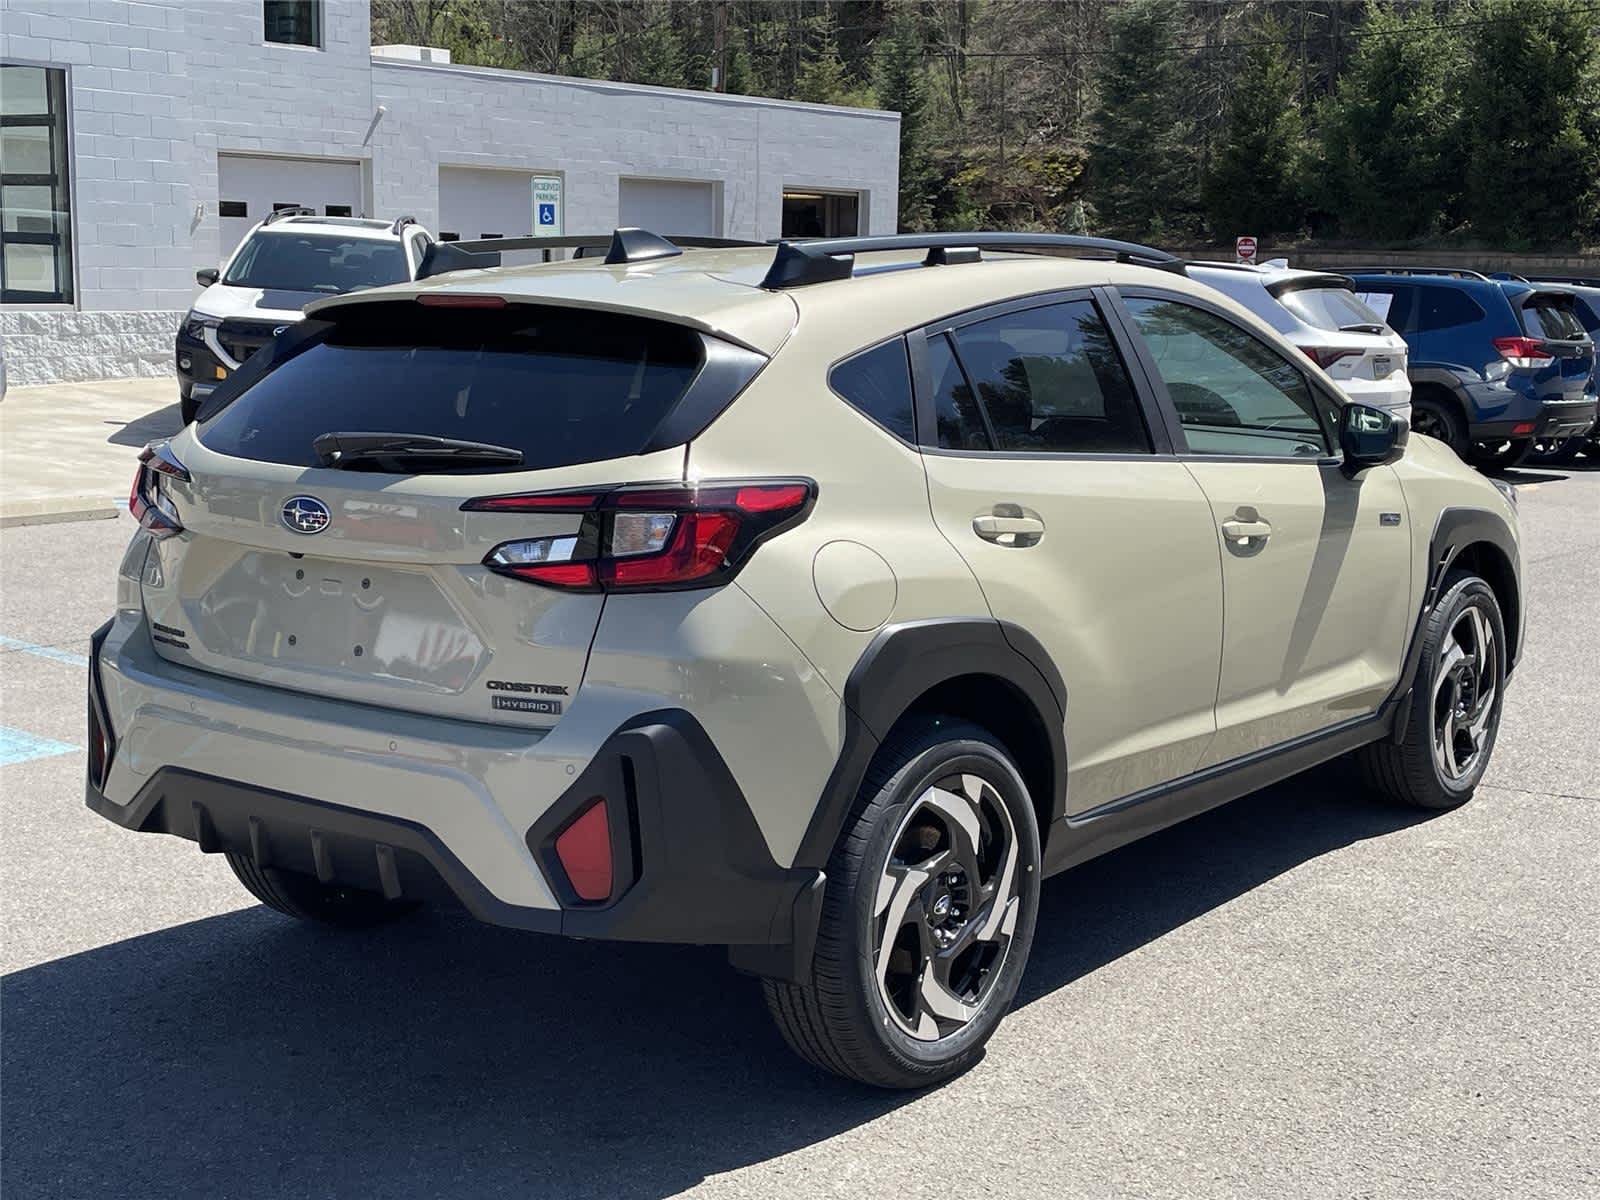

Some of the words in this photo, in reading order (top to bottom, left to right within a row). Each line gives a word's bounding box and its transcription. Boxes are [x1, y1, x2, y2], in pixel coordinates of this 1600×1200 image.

[534, 182, 560, 191] RESERVED
[535, 193, 559, 201] PARKING
[486, 680, 569, 696] CROSSTREK
[502, 700, 549, 711] HYBRID
